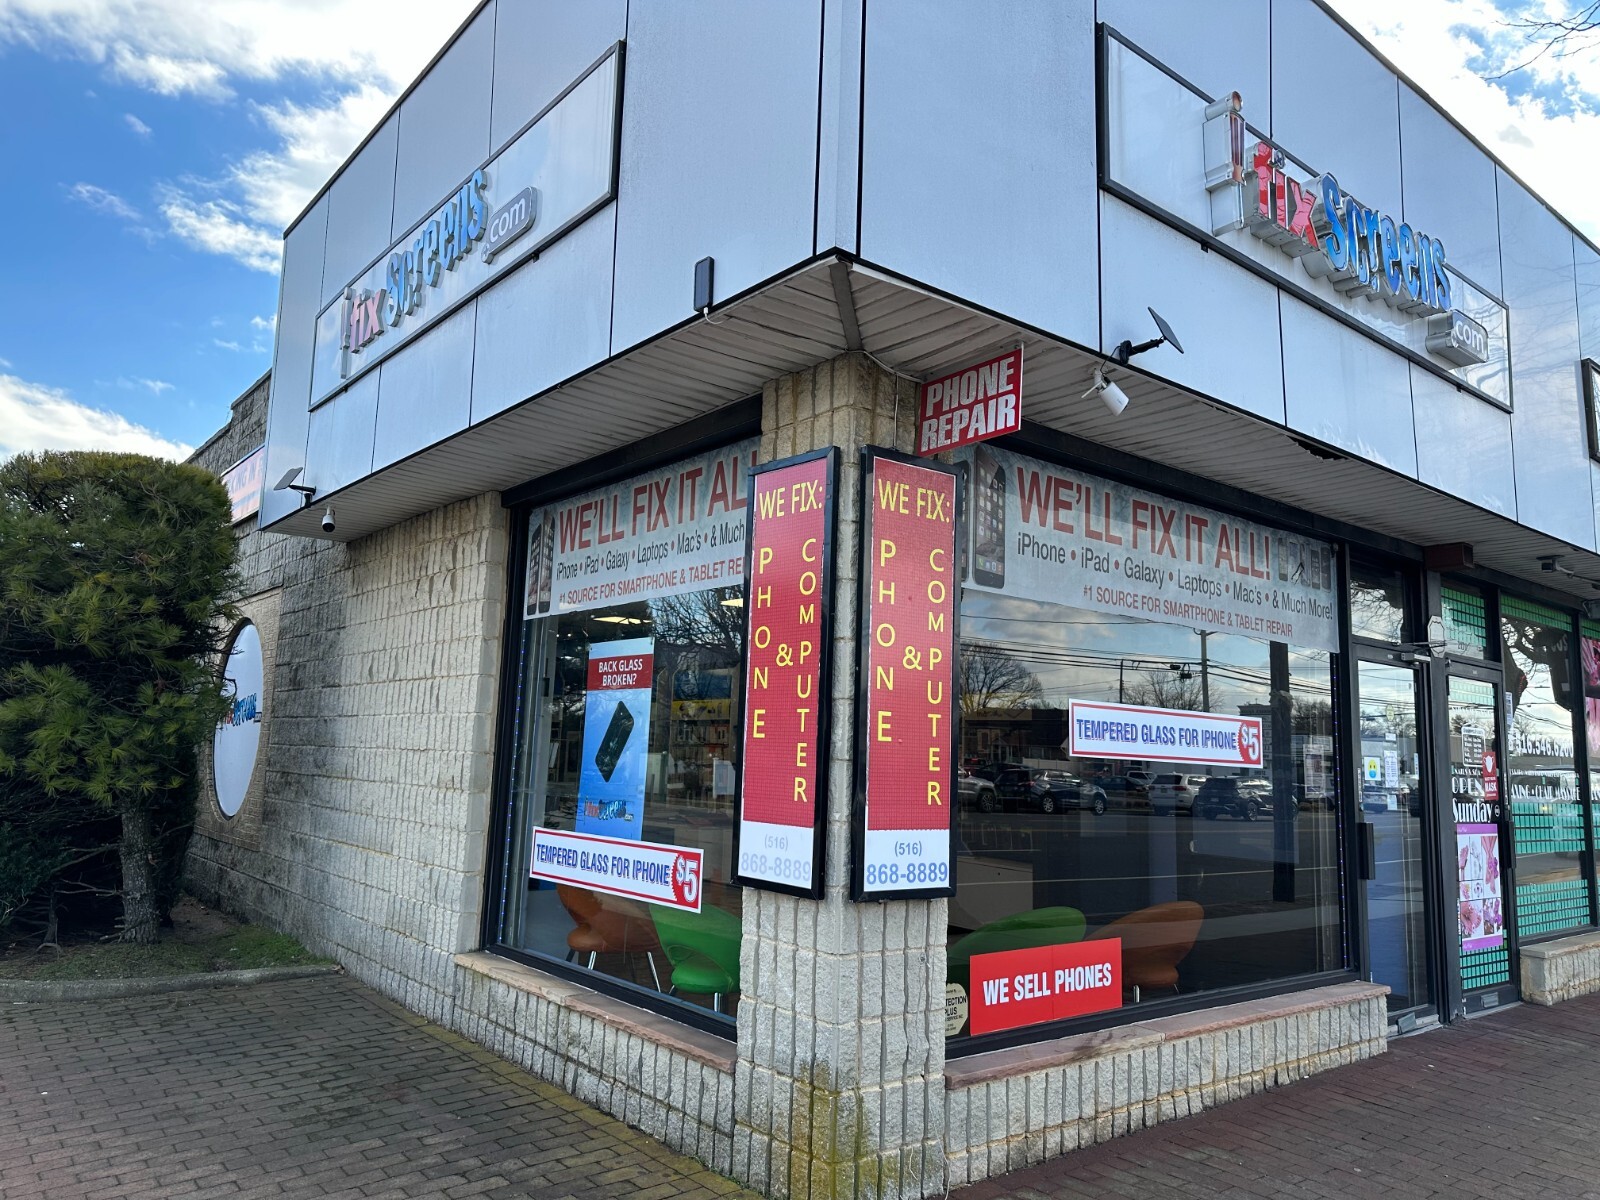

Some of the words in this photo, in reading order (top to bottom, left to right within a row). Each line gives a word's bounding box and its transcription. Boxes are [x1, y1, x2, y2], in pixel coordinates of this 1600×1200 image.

[925, 356, 1015, 417] PHONE
[921, 394, 1016, 452] REPAIR
[559, 494, 625, 554] WE'LL
[631, 477, 671, 536] FIX
[677, 467, 703, 524] IT
[759, 487, 786, 521] WE
[791, 480, 823, 513] FIX:
[878, 478, 910, 515] WE
[916, 487, 950, 523] FIX:
[1016, 466, 1123, 546] WE'LL
[1131, 499, 1177, 559] FIX
[1185, 513, 1209, 565] IT
[1214, 523, 1271, 581] ALL!
[556, 562, 578, 581] iPhone
[583, 555, 599, 576] iPad
[605, 550, 630, 572] Galaxy
[637, 542, 669, 569] Laptops
[676, 531, 702, 555] Mac's
[710, 525, 717, 548] &
[719, 519, 745, 544] Much
[567, 586, 598, 605] SOURCE
[600, 583, 616, 600] FOR
[617, 570, 677, 596] SMARTPHONE
[679, 570, 686, 584] &
[688, 561, 726, 583] TABLET
[1017, 532, 1066, 564] iPhone
[1081, 546, 1110, 574] iPad
[1124, 558, 1165, 590] Galaxy
[1178, 569, 1222, 600] Laptops
[1233, 580, 1262, 606] Mac's
[1272, 590, 1280, 609] &
[1281, 592, 1307, 613] Much
[1308, 597, 1333, 621] More!
[1083, 584, 1093, 601] #1
[1096, 586, 1139, 610] SOURCE
[1141, 595, 1161, 614] FOR
[1163, 600, 1225, 625] SMARTPHONE
[1227, 612, 1233, 627] &
[1235, 613, 1265, 632] TABLET
[1266, 620, 1293, 637] REPAIR
[752, 547, 773, 738] PHONE
[775, 644, 794, 667] &
[876, 539, 897, 742] PHONE
[902, 645, 922, 670] &
[598, 660, 618, 673] BACK
[618, 658, 643, 671] GLASS
[602, 674, 638, 687] BROKEN?
[794, 538, 817, 803] COMPUTER
[927, 548, 946, 806] COMPUTER
[1076, 718, 1138, 743] TEMPERED
[1141, 725, 1176, 746] GLASS
[1178, 727, 1199, 747] FOR
[1201, 729, 1237, 750] IPHONE
[1452, 777, 1485, 797] OPEN
[1453, 798, 1493, 824] Sunday
[536, 843, 578, 870] TEMPERED
[580, 852, 608, 874] GLASS
[610, 856, 630, 878] FOR
[632, 861, 671, 886] IPHONE
[764, 834, 789, 852] (516)
[894, 840, 923, 857] (516)
[741, 852, 811, 882] 868-8889
[866, 862, 948, 885] 868-8889
[946, 995, 967, 1006] TECTION
[983, 978, 1010, 1006] WE
[1014, 972, 1051, 1001] SELL
[1055, 962, 1112, 994] PHONES
